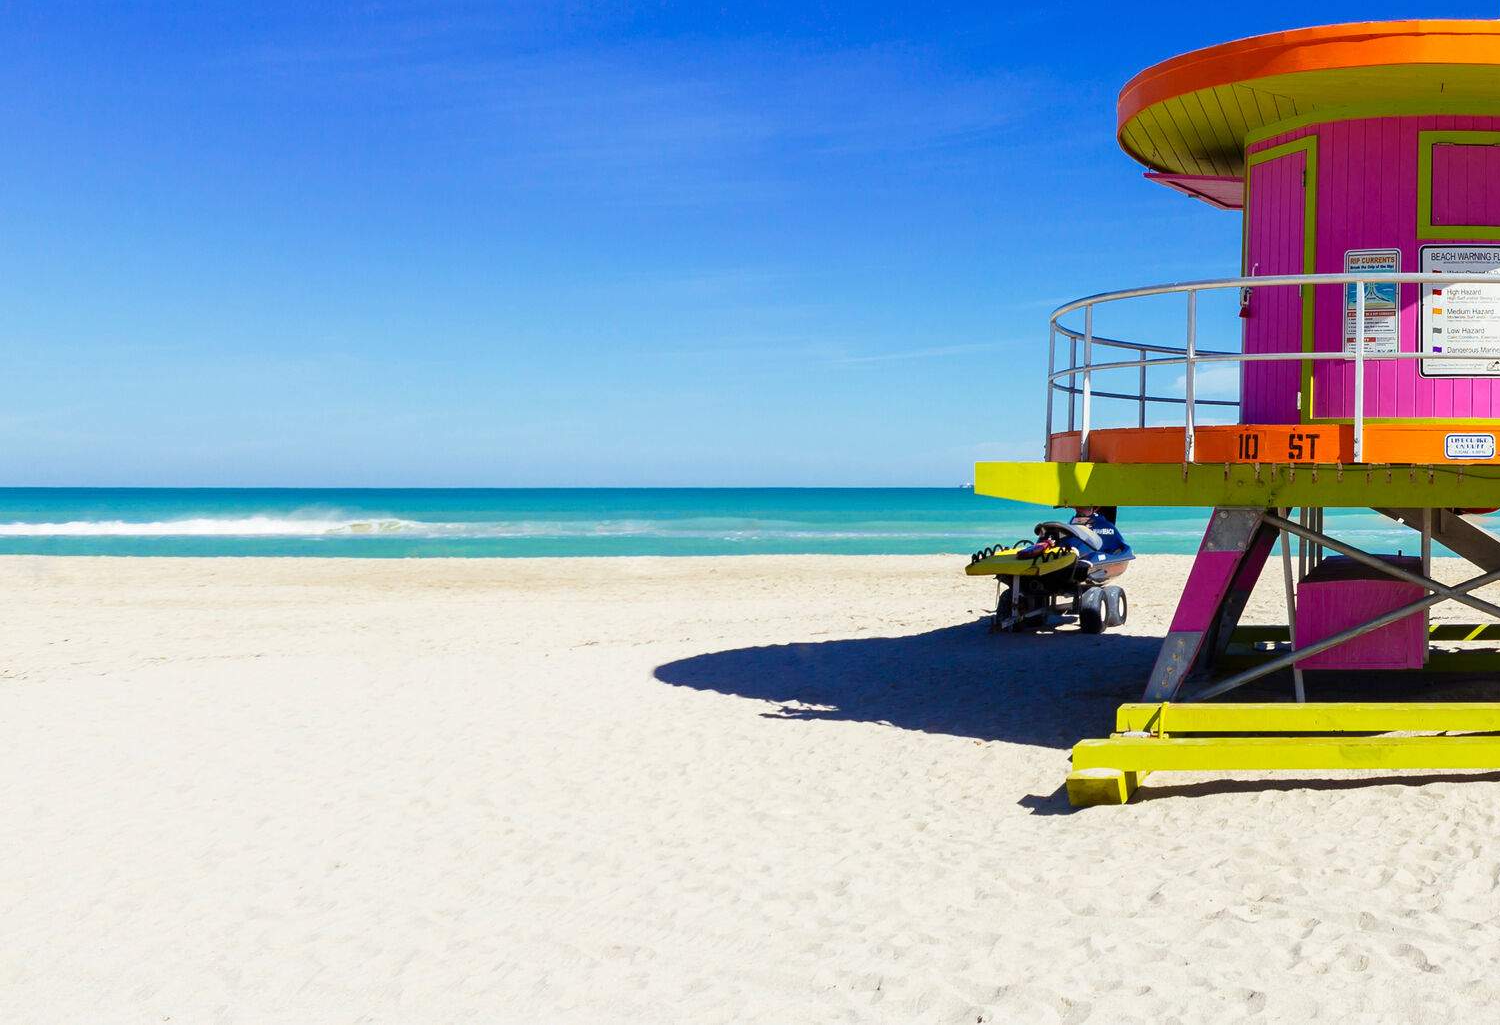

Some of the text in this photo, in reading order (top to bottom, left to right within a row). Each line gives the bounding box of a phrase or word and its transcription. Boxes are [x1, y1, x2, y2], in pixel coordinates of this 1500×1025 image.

[1361, 256, 1395, 264] CURRENTS
[1431, 252, 1456, 261] BEACH
[1457, 252, 1491, 261] WARNING
[1447, 346, 1479, 354] Dangerous
[1480, 346, 1500, 354] Marine
[1238, 433, 1320, 460] 10 ST
